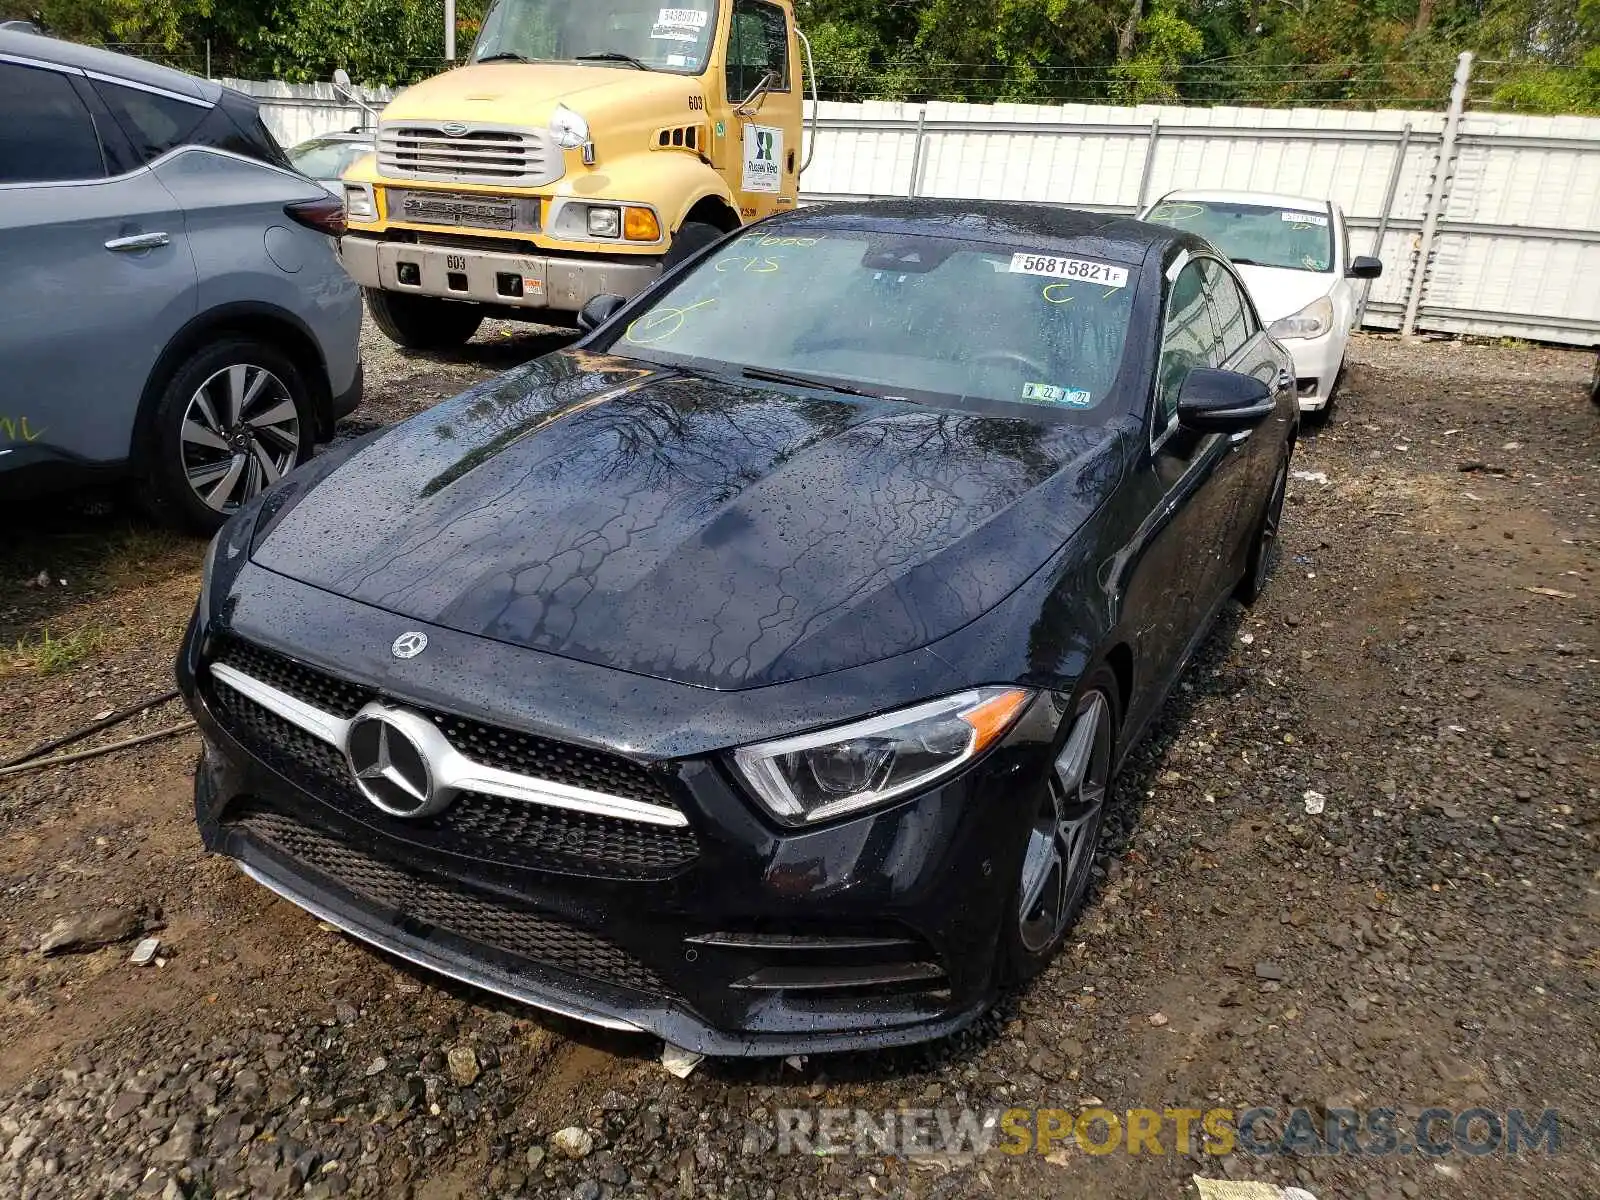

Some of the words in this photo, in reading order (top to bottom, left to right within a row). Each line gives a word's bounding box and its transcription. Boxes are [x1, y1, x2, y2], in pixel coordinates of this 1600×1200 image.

[688, 95, 703, 110] 603
[447, 255, 466, 271] 603
[1023, 256, 1111, 281] 56815821
[1043, 387, 1054, 399] 22
